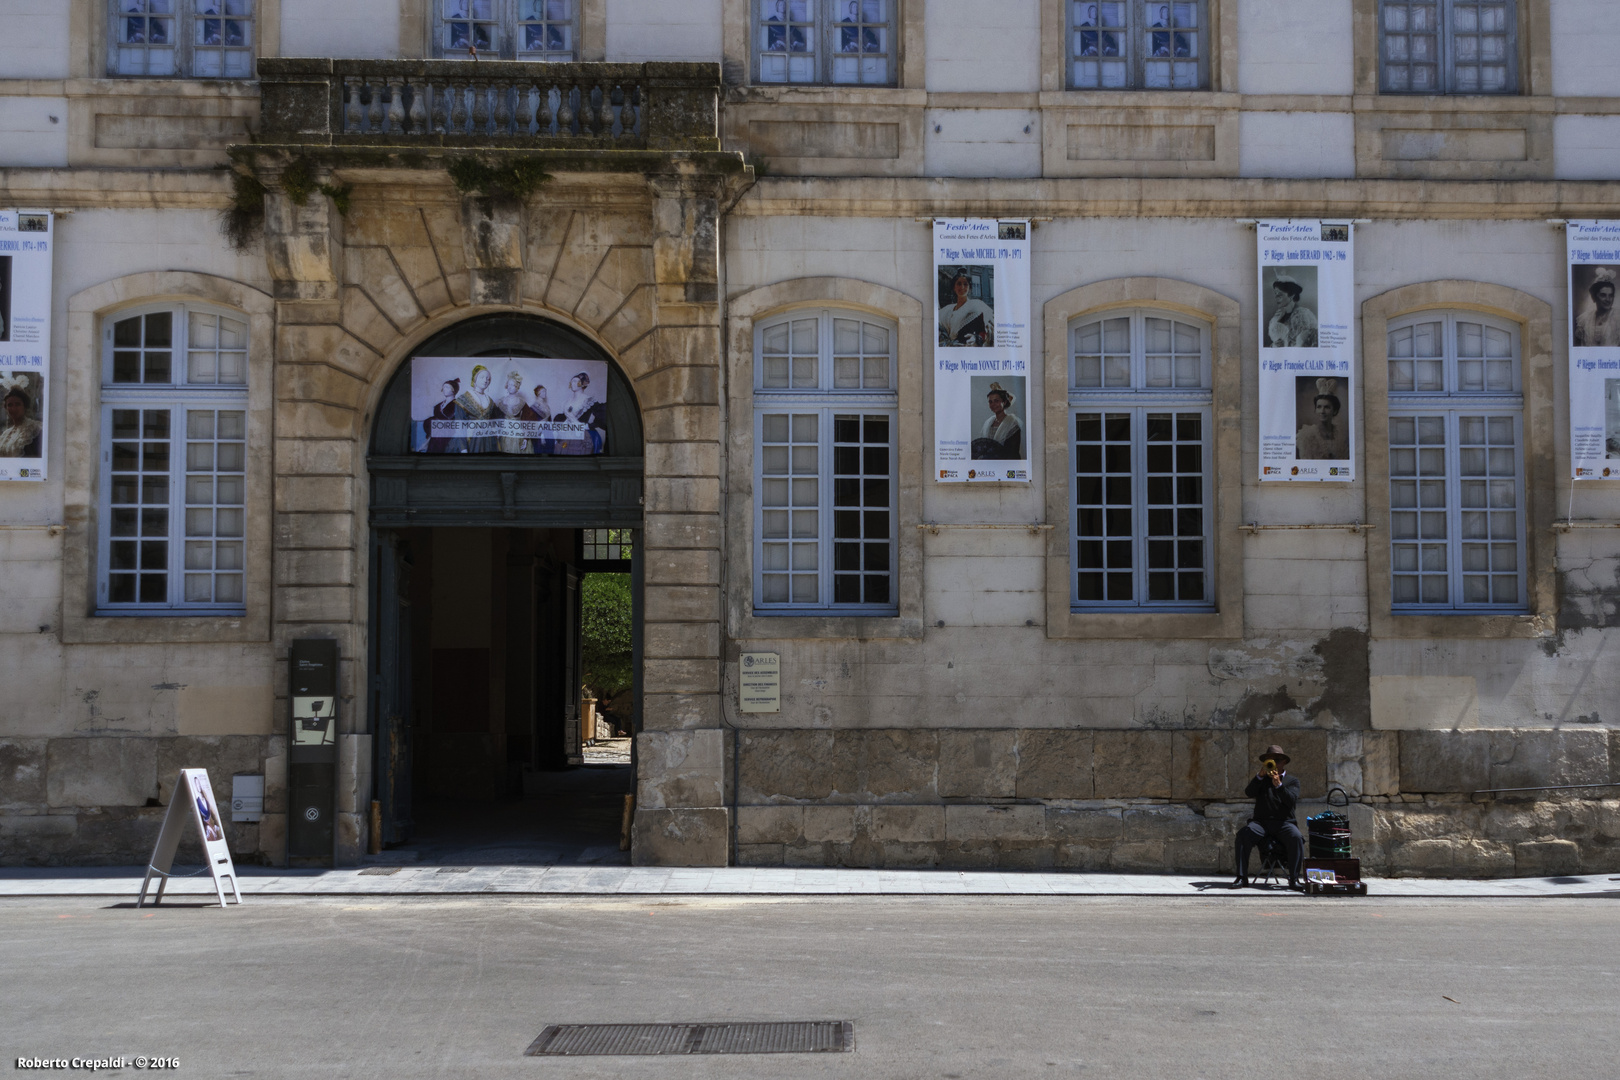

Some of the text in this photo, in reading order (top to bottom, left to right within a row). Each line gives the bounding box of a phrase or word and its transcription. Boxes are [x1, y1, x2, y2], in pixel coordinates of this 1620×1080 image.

[946, 248, 959, 261] Règne
[962, 248, 975, 258] Nicole
[976, 249, 996, 259] MICHEL
[999, 249, 1008, 259] 1970
[1012, 249, 1022, 259] 1971
[1271, 250, 1284, 262] Règne
[1286, 250, 1299, 260] Annie
[1300, 250, 1320, 260] BERARD
[1323, 250, 1332, 260] 1962
[1336, 250, 1346, 260] 1966
[1577, 250, 1590, 262] Règne
[1592, 250, 1613, 260] Madeleine
[16, 355, 27, 366] 1978
[32, 355, 42, 366] 1981
[945, 360, 958, 373] Règne
[961, 360, 978, 372] Myriam
[979, 360, 1000, 370] YONNET
[1002, 360, 1011, 370] 1971
[1015, 360, 1025, 370] 1974
[1269, 360, 1282, 373] Règne
[1284, 360, 1304, 372] Françoise
[1305, 360, 1323, 370] CALAIS
[1326, 360, 1336, 370] 1966
[1339, 360, 1348, 370] 1970
[1583, 360, 1596, 372] Règne
[1598, 360, 1618, 369] Henriette
[432, 421, 459, 429] SOIRÉE
[508, 421, 535, 430] SOIRÉE
[538, 422, 584, 431] ARLÉSIENNE
